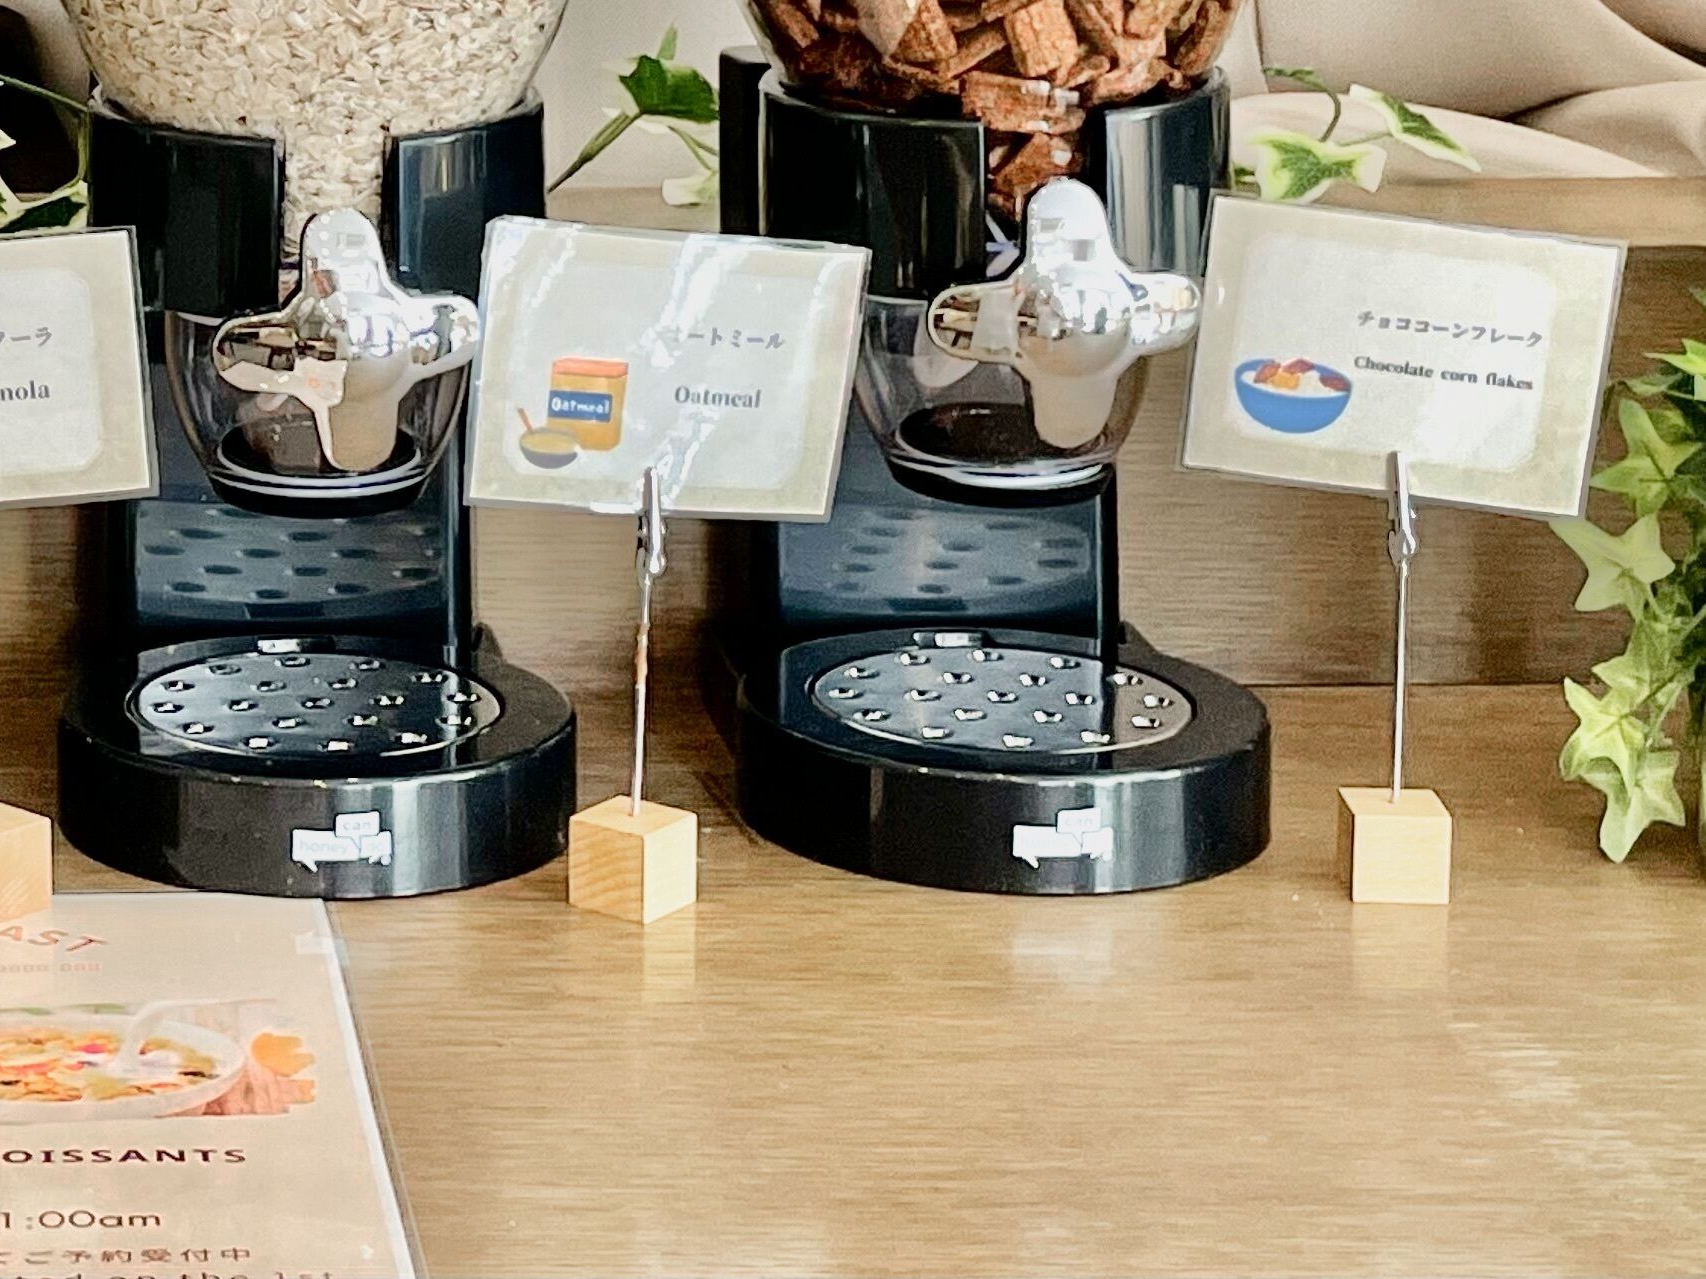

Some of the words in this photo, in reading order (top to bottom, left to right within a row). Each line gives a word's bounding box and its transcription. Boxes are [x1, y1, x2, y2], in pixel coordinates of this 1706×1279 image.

[1357, 310, 1544, 348] チョココーンフレーク
[1353, 355, 1435, 379] Chocolate
[1440, 369, 1479, 384] corn
[1485, 371, 1535, 391] flakes
[551, 397, 610, 415] Oatmeal
[674, 384, 763, 409] Oatmeal
[341, 819, 371, 831] can
